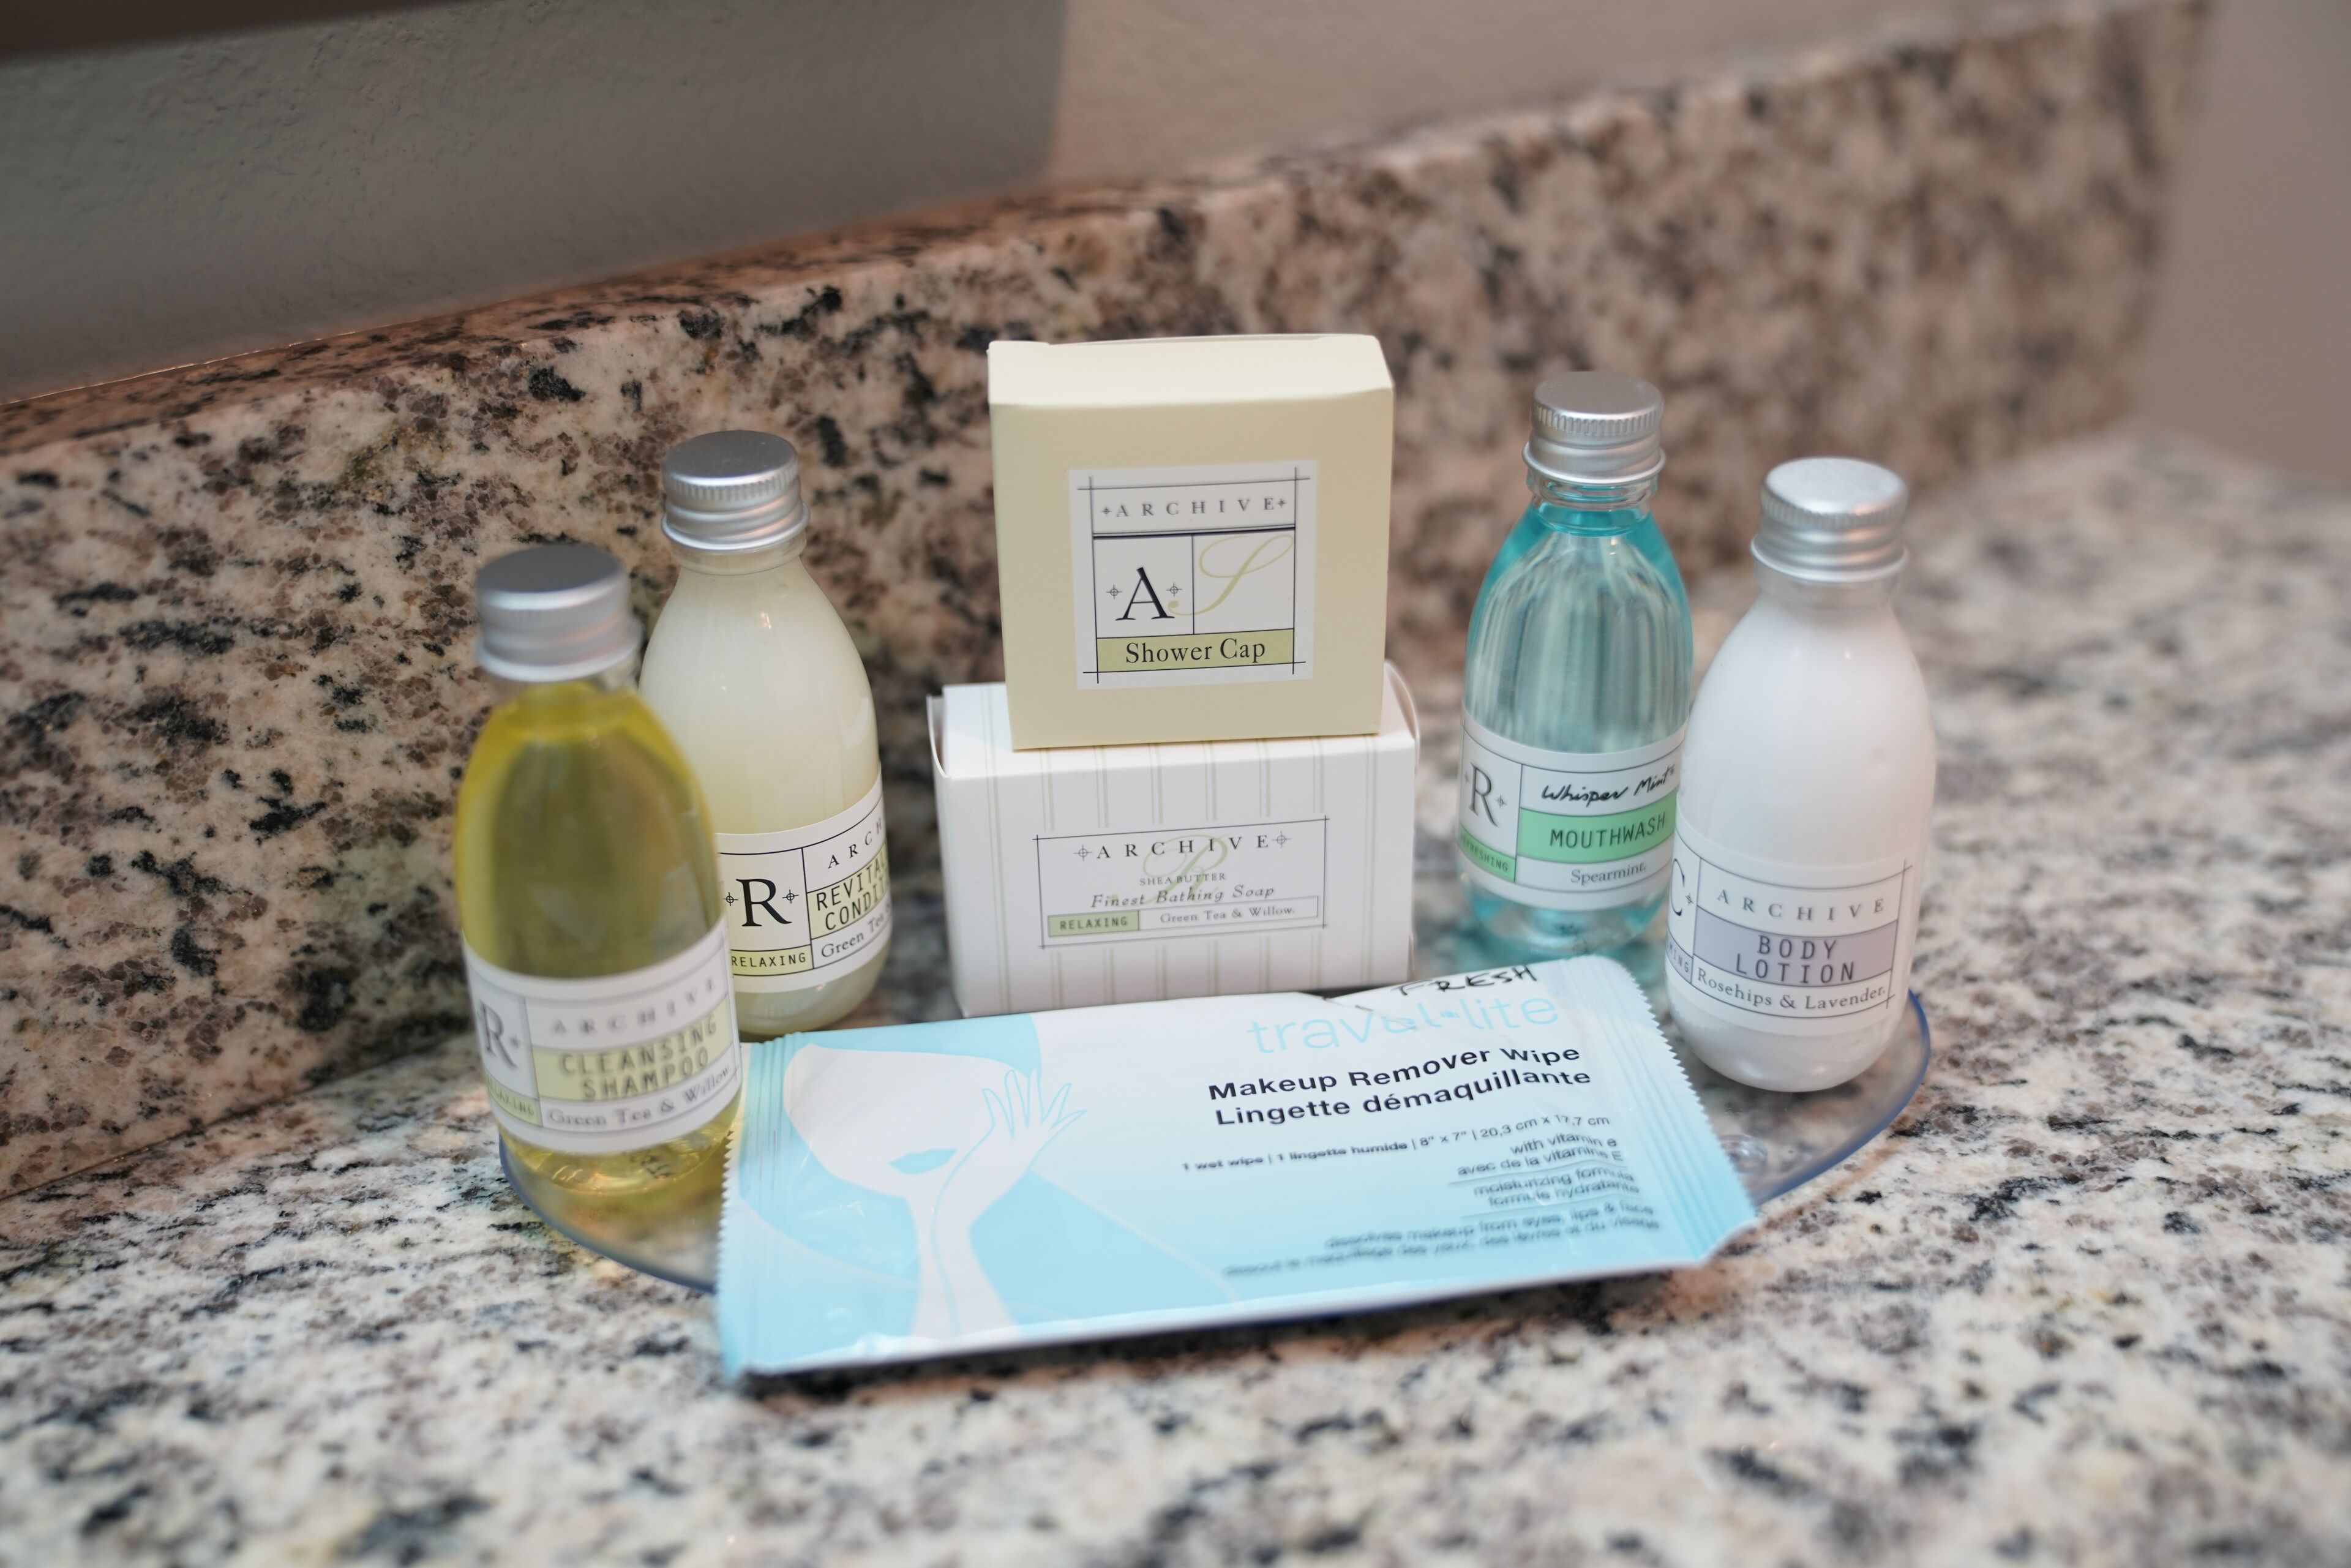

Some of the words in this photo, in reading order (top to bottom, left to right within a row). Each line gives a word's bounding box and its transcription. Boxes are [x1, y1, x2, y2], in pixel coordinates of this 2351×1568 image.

[1116, 497, 1274, 517] ARCHIVE
[1115, 566, 1175, 621] A
[1126, 642, 1212, 664] Shower
[1220, 638, 1265, 662] Cap
[1469, 763, 1499, 827] R
[1541, 784, 1629, 808] Whisper
[1550, 811, 1665, 849] MOUTHWASH
[1097, 833, 1269, 859] ARCHIVE
[1139, 877, 1172, 886] SHEA
[1177, 872, 1226, 883] BUTTER
[735, 879, 792, 927] R
[1090, 893, 1145, 909] Finest
[1157, 887, 1224, 904] Bathing
[1232, 885, 1275, 899] Soap
[1717, 888, 1884, 921] ARCHIVE
[1060, 916, 1129, 930] RELAXING
[1160, 912, 1198, 923] Green
[1204, 910, 1226, 920] Tea
[1232, 909, 1242, 918] &
[821, 932, 864, 958] Green
[868, 915, 885, 934] Tea
[1757, 934, 1837, 959] BODY
[731, 953, 806, 967] RELAXING
[1736, 953, 1854, 984] LOTION
[1697, 967, 1772, 1007] Rosehips
[1780, 994, 1796, 1008] &
[552, 978, 715, 1036] ARCHIVE
[478, 998, 519, 1070] R
[561, 1016, 718, 1076] CLEANSING
[582, 1046, 709, 1100] SHAMPOO
[1209, 1076, 1337, 1100] Makeup
[1348, 1050, 1490, 1086] Remover
[1216, 1100, 1351, 1125] Lingette
[1363, 1069, 1591, 1112] démaquillante
[549, 1109, 607, 1126] Green
[618, 1106, 651, 1124] Tea
[660, 1100, 676, 1114] &
[1195, 1160, 1224, 1170] wet
[1228, 1156, 1264, 1168] wipe
[1290, 1147, 1347, 1161] lingette
[1351, 1141, 1408, 1153] humide
[1480, 1125, 1512, 1138] 20,3
[1516, 1119, 1537, 1131] cm
[1588, 1117, 1610, 1125] cm
[1510, 1140, 1543, 1155] with
[1549, 1133, 1602, 1147] vitamin
[1458, 1163, 1496, 1176] avec
[1500, 1158, 1521, 1169] de
[1524, 1156, 1540, 1166] la
[1543, 1147, 1608, 1163] vitamine
[1611, 1150, 1624, 1161] E
[1473, 1172, 1572, 1196] moisturizing
